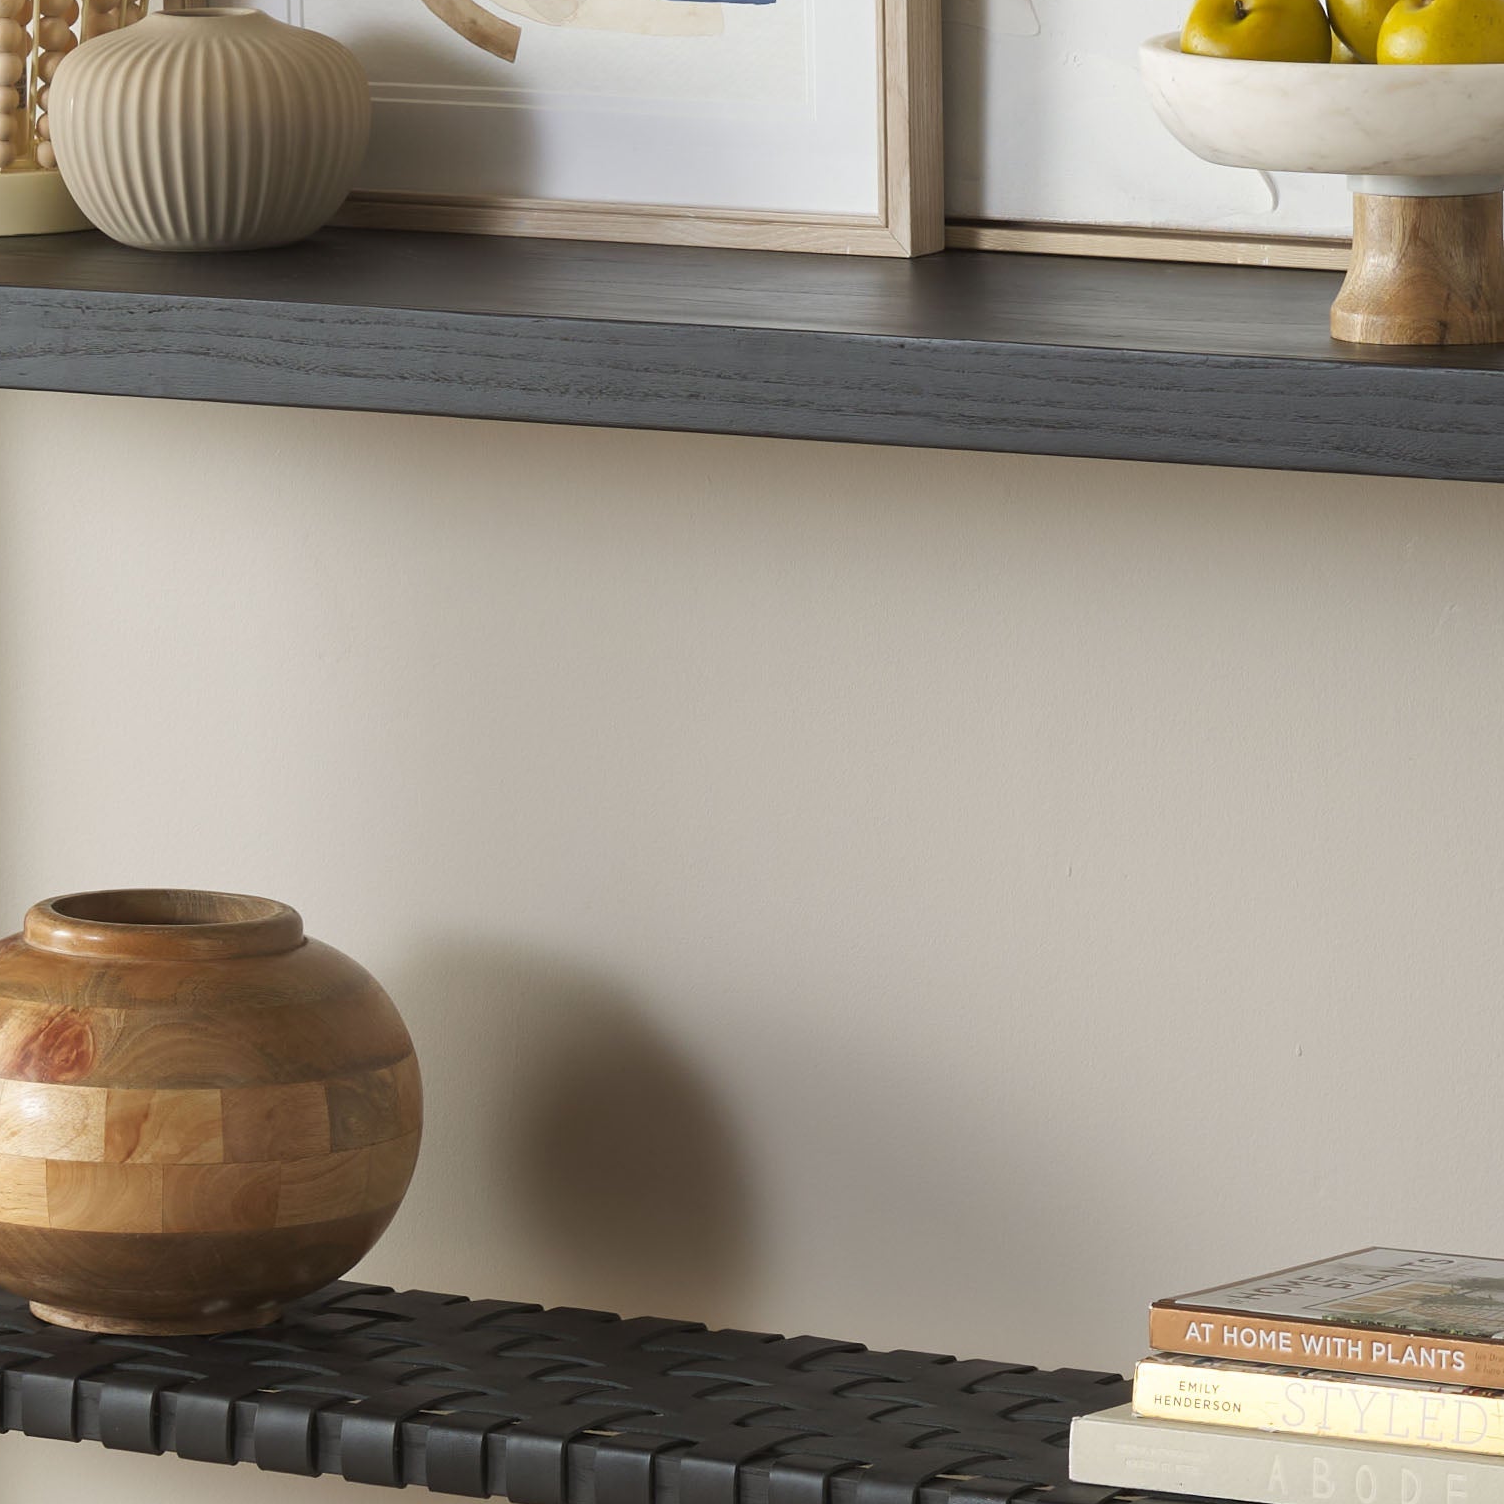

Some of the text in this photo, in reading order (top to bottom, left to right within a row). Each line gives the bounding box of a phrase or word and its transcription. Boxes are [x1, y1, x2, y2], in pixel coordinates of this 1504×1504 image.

[1234, 1274, 1329, 1301] HOME
[1322, 1257, 1455, 1290] PLANTS
[1185, 1321, 1466, 1371] AT HOME WITH PLANTS
[1179, 1380, 1220, 1394] EMILY
[1154, 1394, 1242, 1413] HENDERSON
[1281, 1382, 1488, 1445] STYLED
